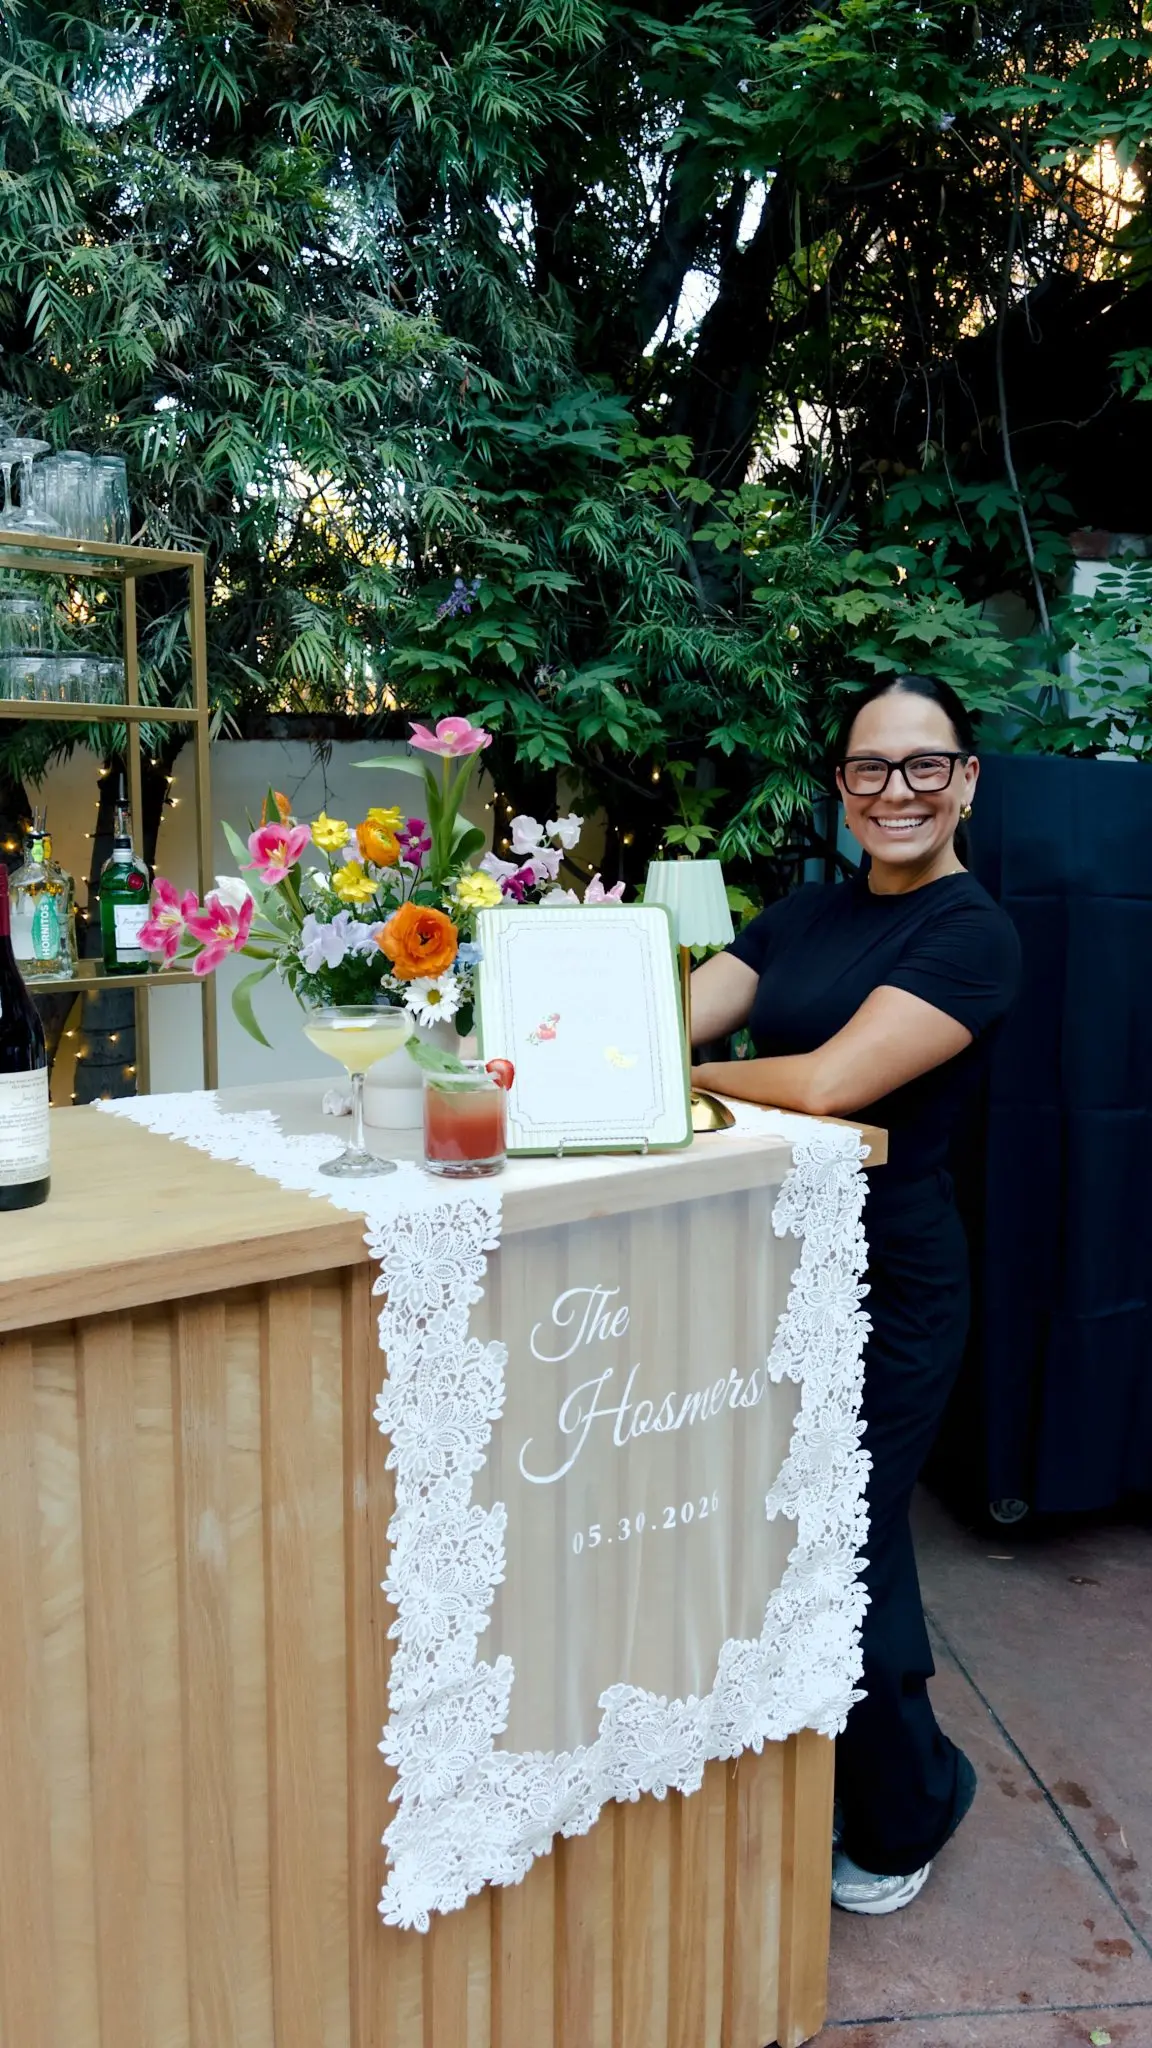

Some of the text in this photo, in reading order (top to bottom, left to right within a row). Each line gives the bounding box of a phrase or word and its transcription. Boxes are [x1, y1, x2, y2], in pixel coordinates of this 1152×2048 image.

[41, 904, 51, 956] HORNITOS
[530, 1284, 629, 1362] The
[519, 1363, 765, 1484] Hosmers
[572, 1488, 719, 1554] 05.30.2026
